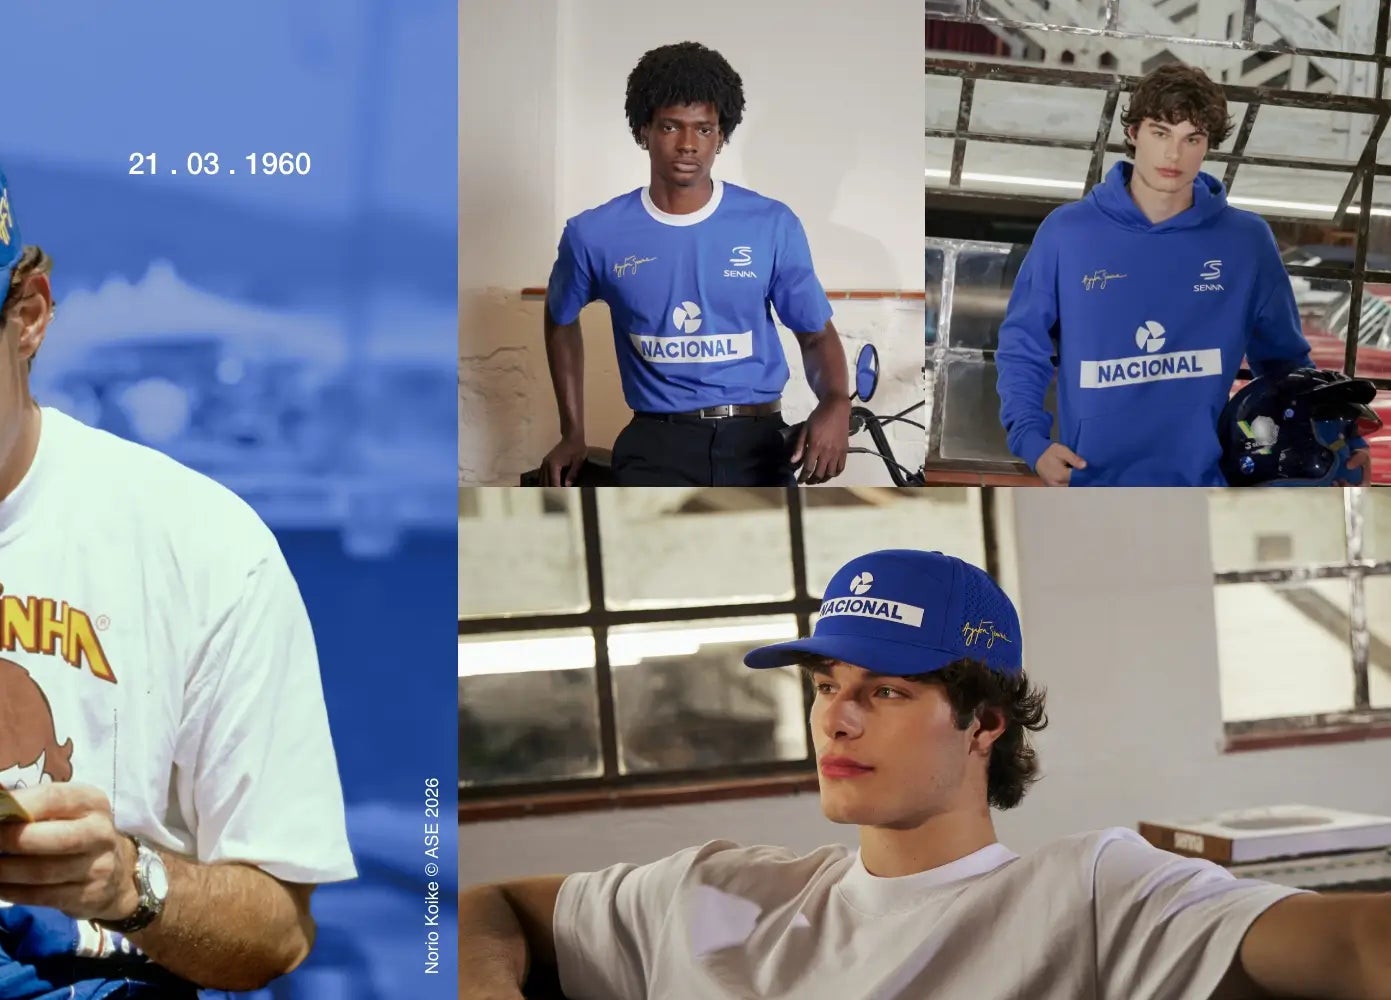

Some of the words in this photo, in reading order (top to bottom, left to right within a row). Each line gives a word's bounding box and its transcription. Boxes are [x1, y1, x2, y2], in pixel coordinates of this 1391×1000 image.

[723, 269, 757, 278] SENNA
[1193, 284, 1224, 292] SENNA
[641, 339, 738, 358] NACIONAL
[1098, 355, 1203, 383] NACIONAL
[820, 599, 903, 620] NACIONAL
